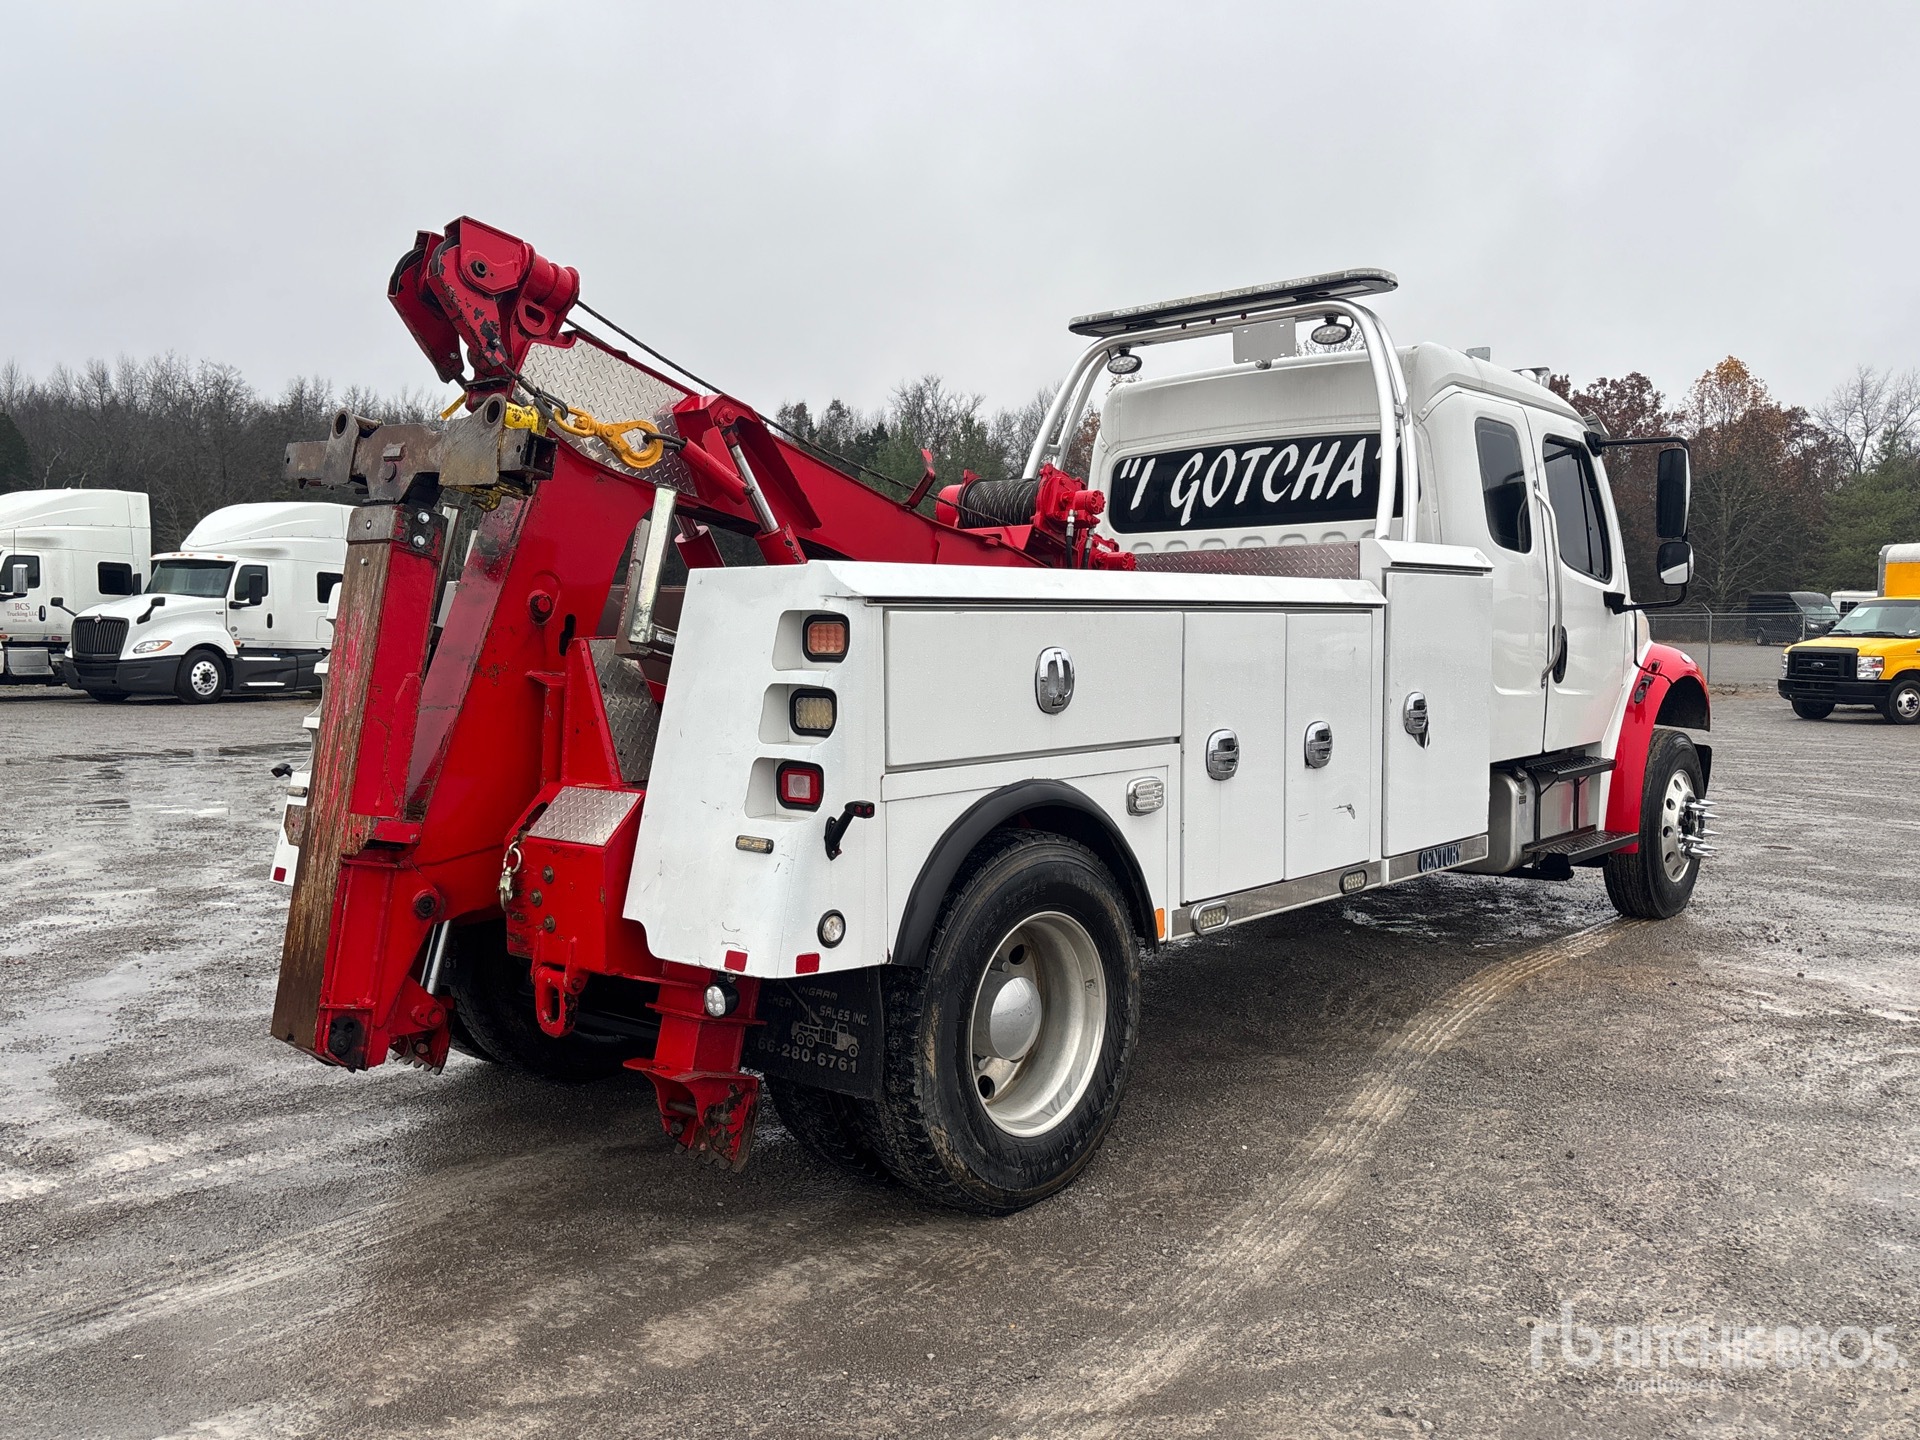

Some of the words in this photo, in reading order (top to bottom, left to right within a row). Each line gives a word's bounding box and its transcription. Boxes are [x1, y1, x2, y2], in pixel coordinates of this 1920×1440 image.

[15, 602, 30, 610] BCS
[1420, 843, 1462, 873] CENTURY
[819, 1006, 851, 1021] SALES
